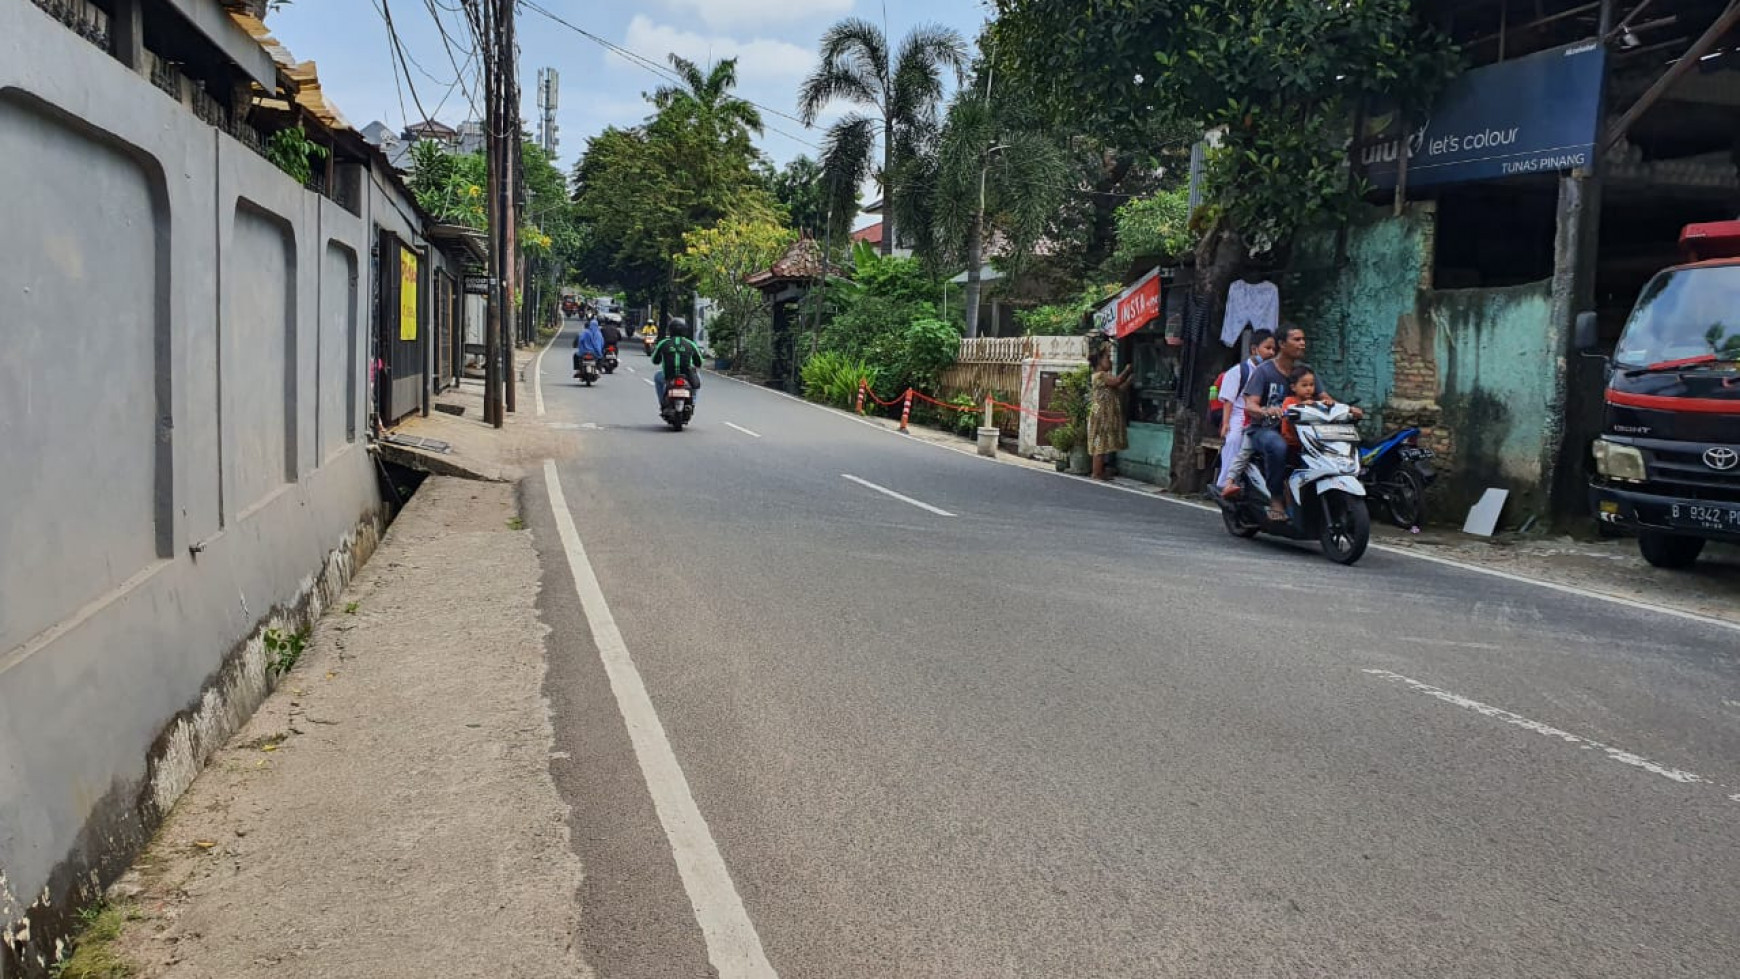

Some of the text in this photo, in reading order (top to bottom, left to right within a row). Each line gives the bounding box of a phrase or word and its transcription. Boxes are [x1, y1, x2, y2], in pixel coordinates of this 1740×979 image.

[1428, 135, 1460, 156] let's
[1463, 126, 1520, 151] colour
[1501, 153, 1585, 174] TUNAS PINANG
[1121, 293, 1146, 326] INSTA
[1672, 505, 1680, 518] B
[1690, 506, 1721, 523] 9342
